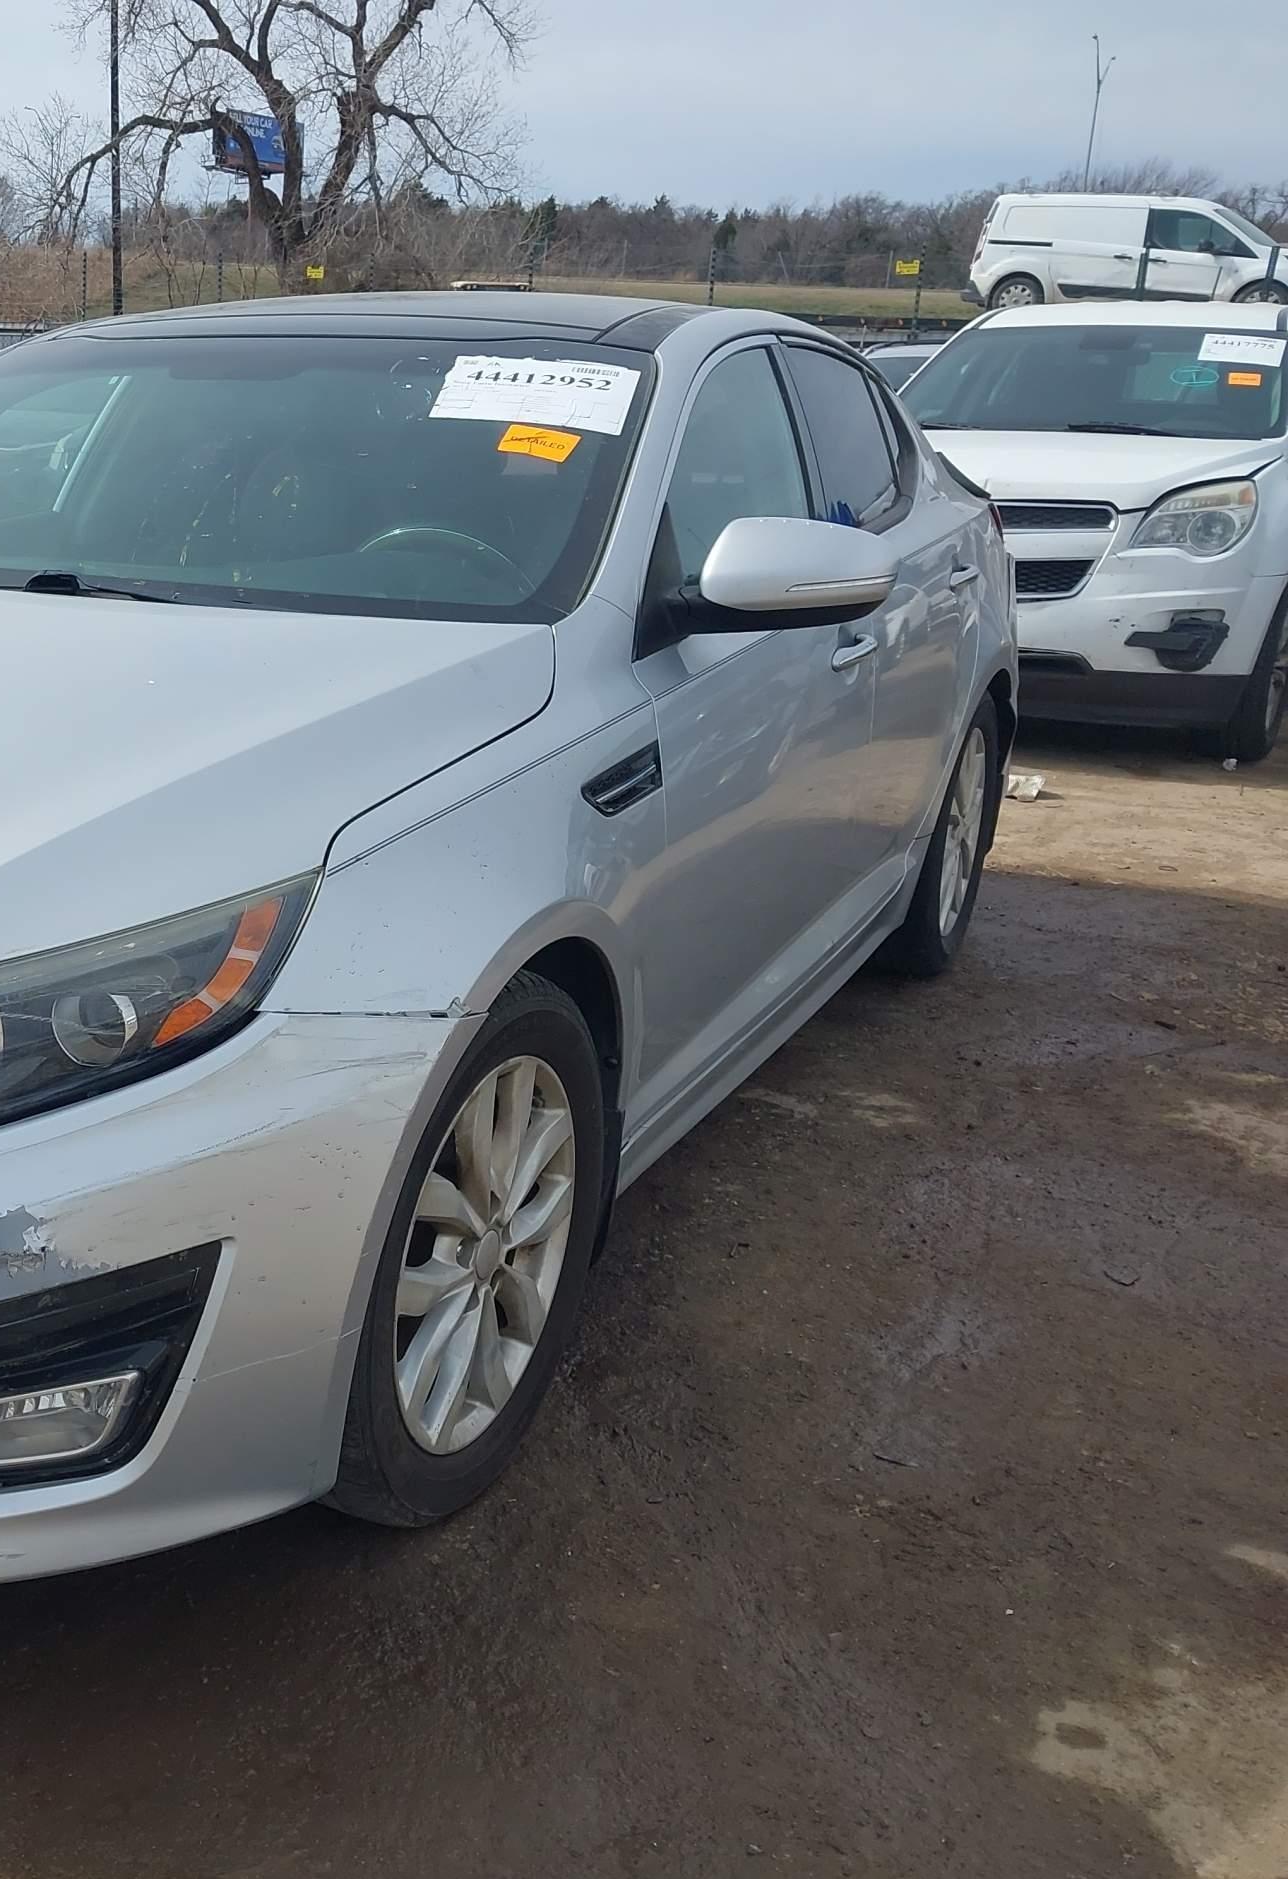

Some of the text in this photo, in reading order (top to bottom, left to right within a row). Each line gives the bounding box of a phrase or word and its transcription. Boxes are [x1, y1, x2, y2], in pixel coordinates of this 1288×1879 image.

[260, 118, 273, 129] CAR
[467, 370, 612, 391] 44412952
[510, 435, 566, 451] DETAILED
